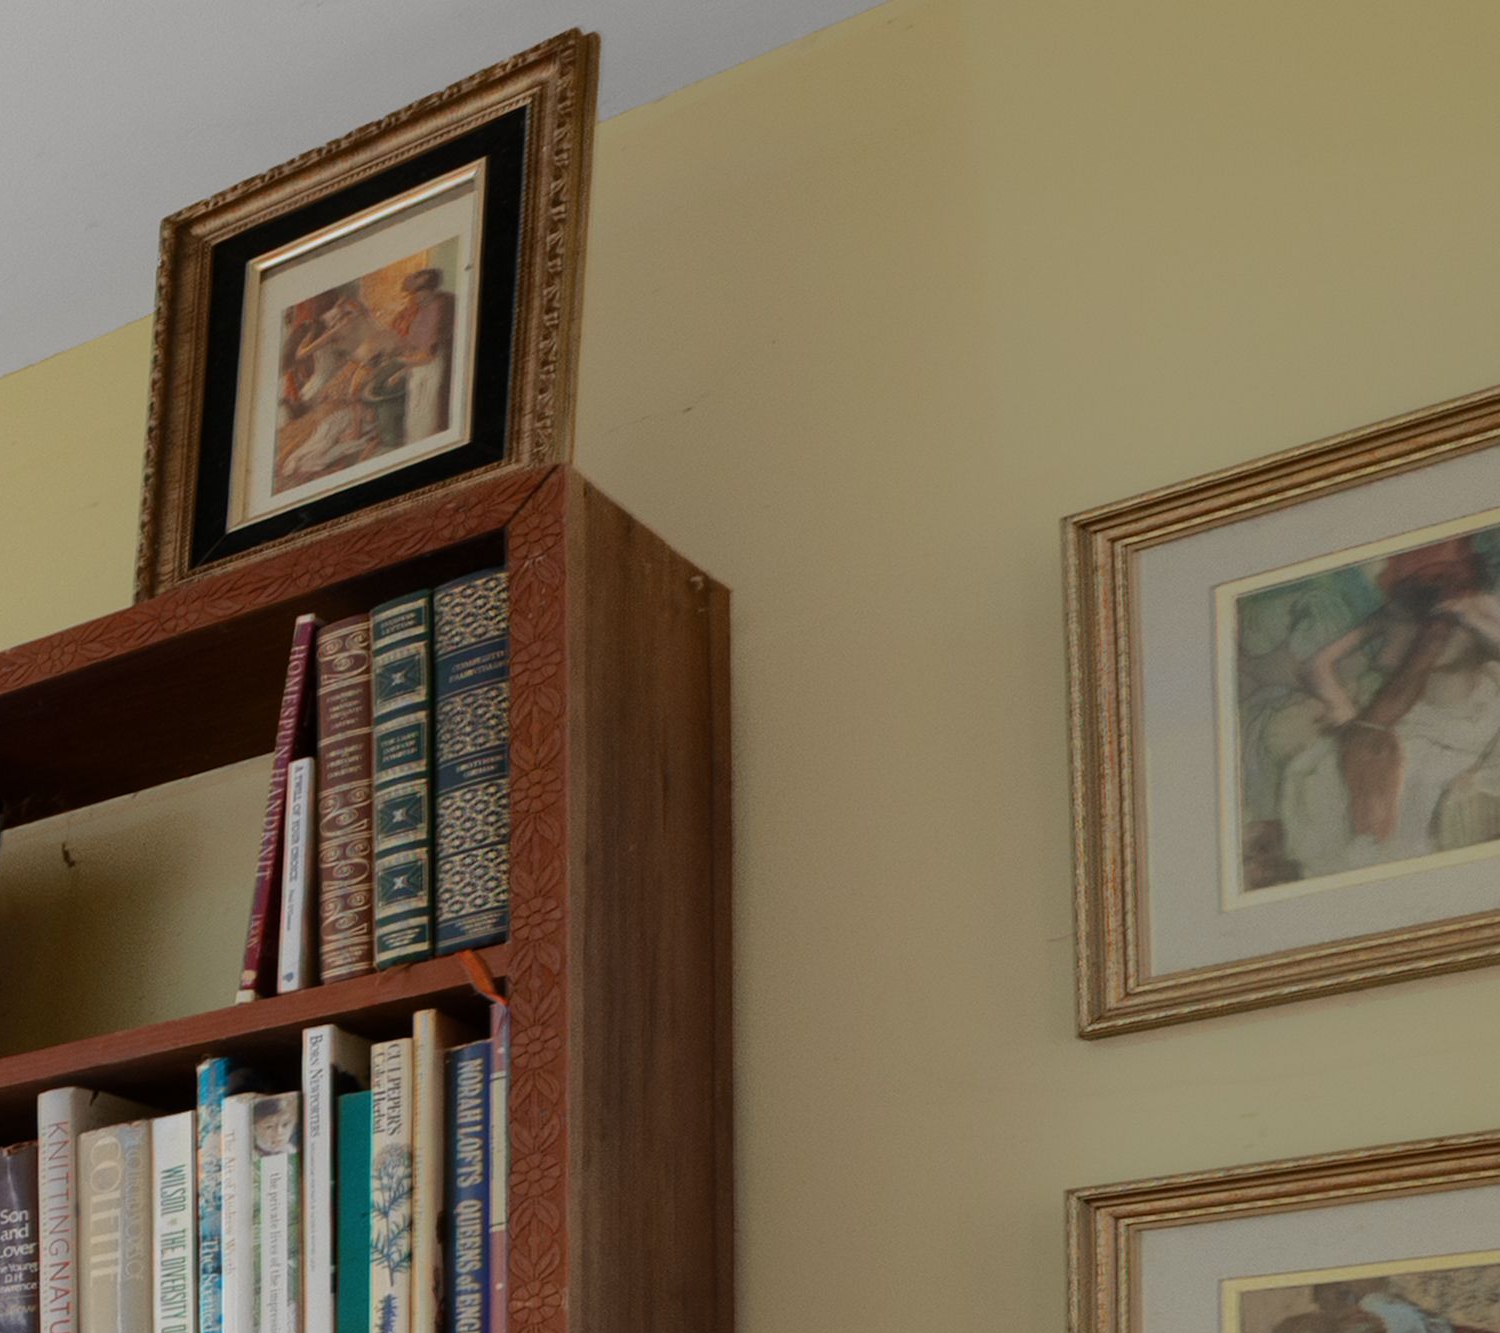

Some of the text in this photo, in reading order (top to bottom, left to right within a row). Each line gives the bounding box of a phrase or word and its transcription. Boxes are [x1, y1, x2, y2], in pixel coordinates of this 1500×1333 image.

[254, 644, 309, 881] HOMESPUN HANDKNIT
[308, 1034, 324, 1138] BORN NEWPORTERS
[386, 1043, 403, 1136] CULPEPER'S
[456, 1058, 483, 1122] NORAH
[269, 1172, 282, 1189] the
[456, 1127, 483, 1187] LOFTS
[0, 1208, 30, 1226] Son
[89, 1136, 122, 1289] COLETTE
[160, 1164, 187, 1218] WILSON
[266, 1191, 282, 1228] private
[0, 1222, 30, 1242] and
[160, 1228, 186, 1256] THE
[201, 1239, 219, 1269] The
[269, 1230, 282, 1255] lives
[454, 1199, 483, 1274] QUEENS
[160, 1258, 187, 1320] DIVERSITY
[269, 1257, 282, 1267] of
[269, 1269, 282, 1286] the
[202, 1273, 219, 1333] Scented
